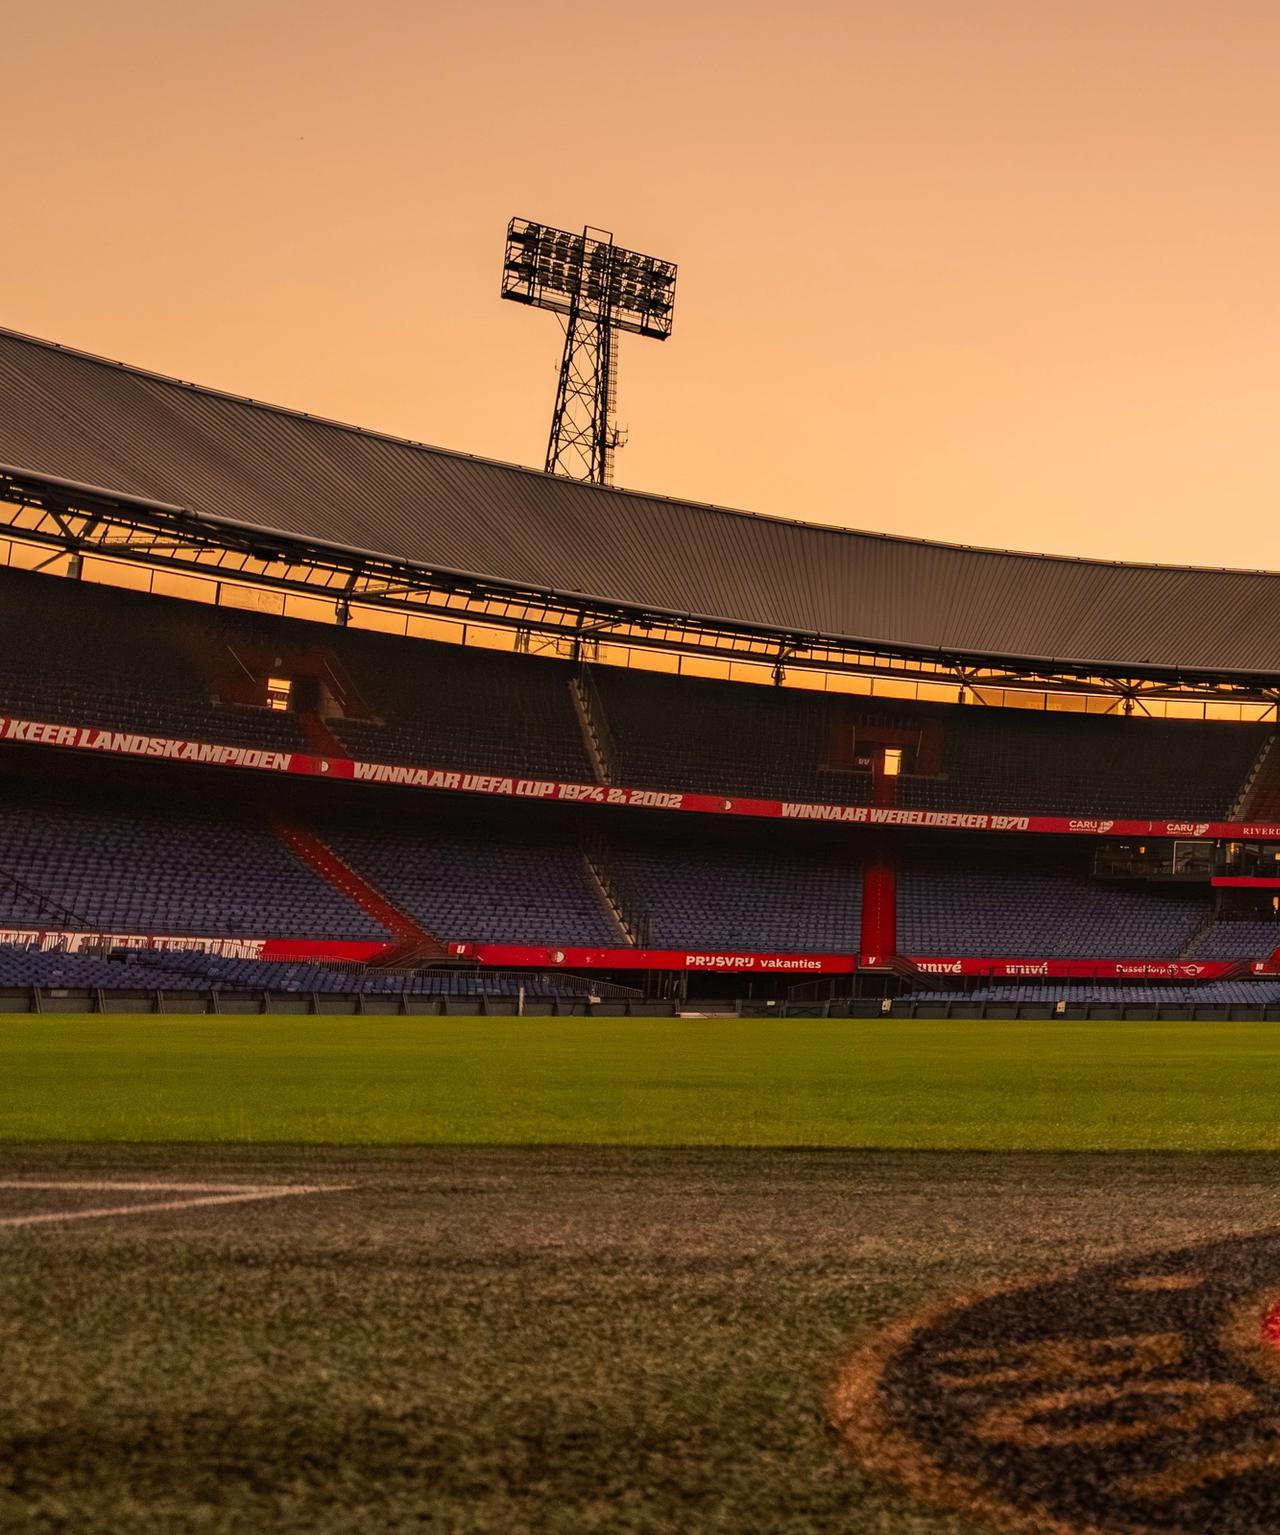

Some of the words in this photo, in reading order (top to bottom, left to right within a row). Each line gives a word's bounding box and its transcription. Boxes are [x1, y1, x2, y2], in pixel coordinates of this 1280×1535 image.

[5, 719, 77, 746] KEER
[77, 728, 292, 771] LANDSKAMPIOEN
[353, 761, 462, 790] WINNAAR
[462, 774, 513, 795] UEFA
[515, 779, 554, 799] CUP
[557, 784, 606, 804] 1974
[629, 790, 683, 809] 2002
[781, 803, 868, 823] WINNAAR
[869, 808, 989, 830] WERELDBEKER
[990, 816, 1030, 831] 1970
[1069, 820, 1098, 829] CARU
[1166, 823, 1194, 832] CARU
[457, 945, 465, 954] U
[760, 958, 822, 970] vakanties
[917, 961, 962, 974] univé
[1006, 962, 1049, 975] univé
